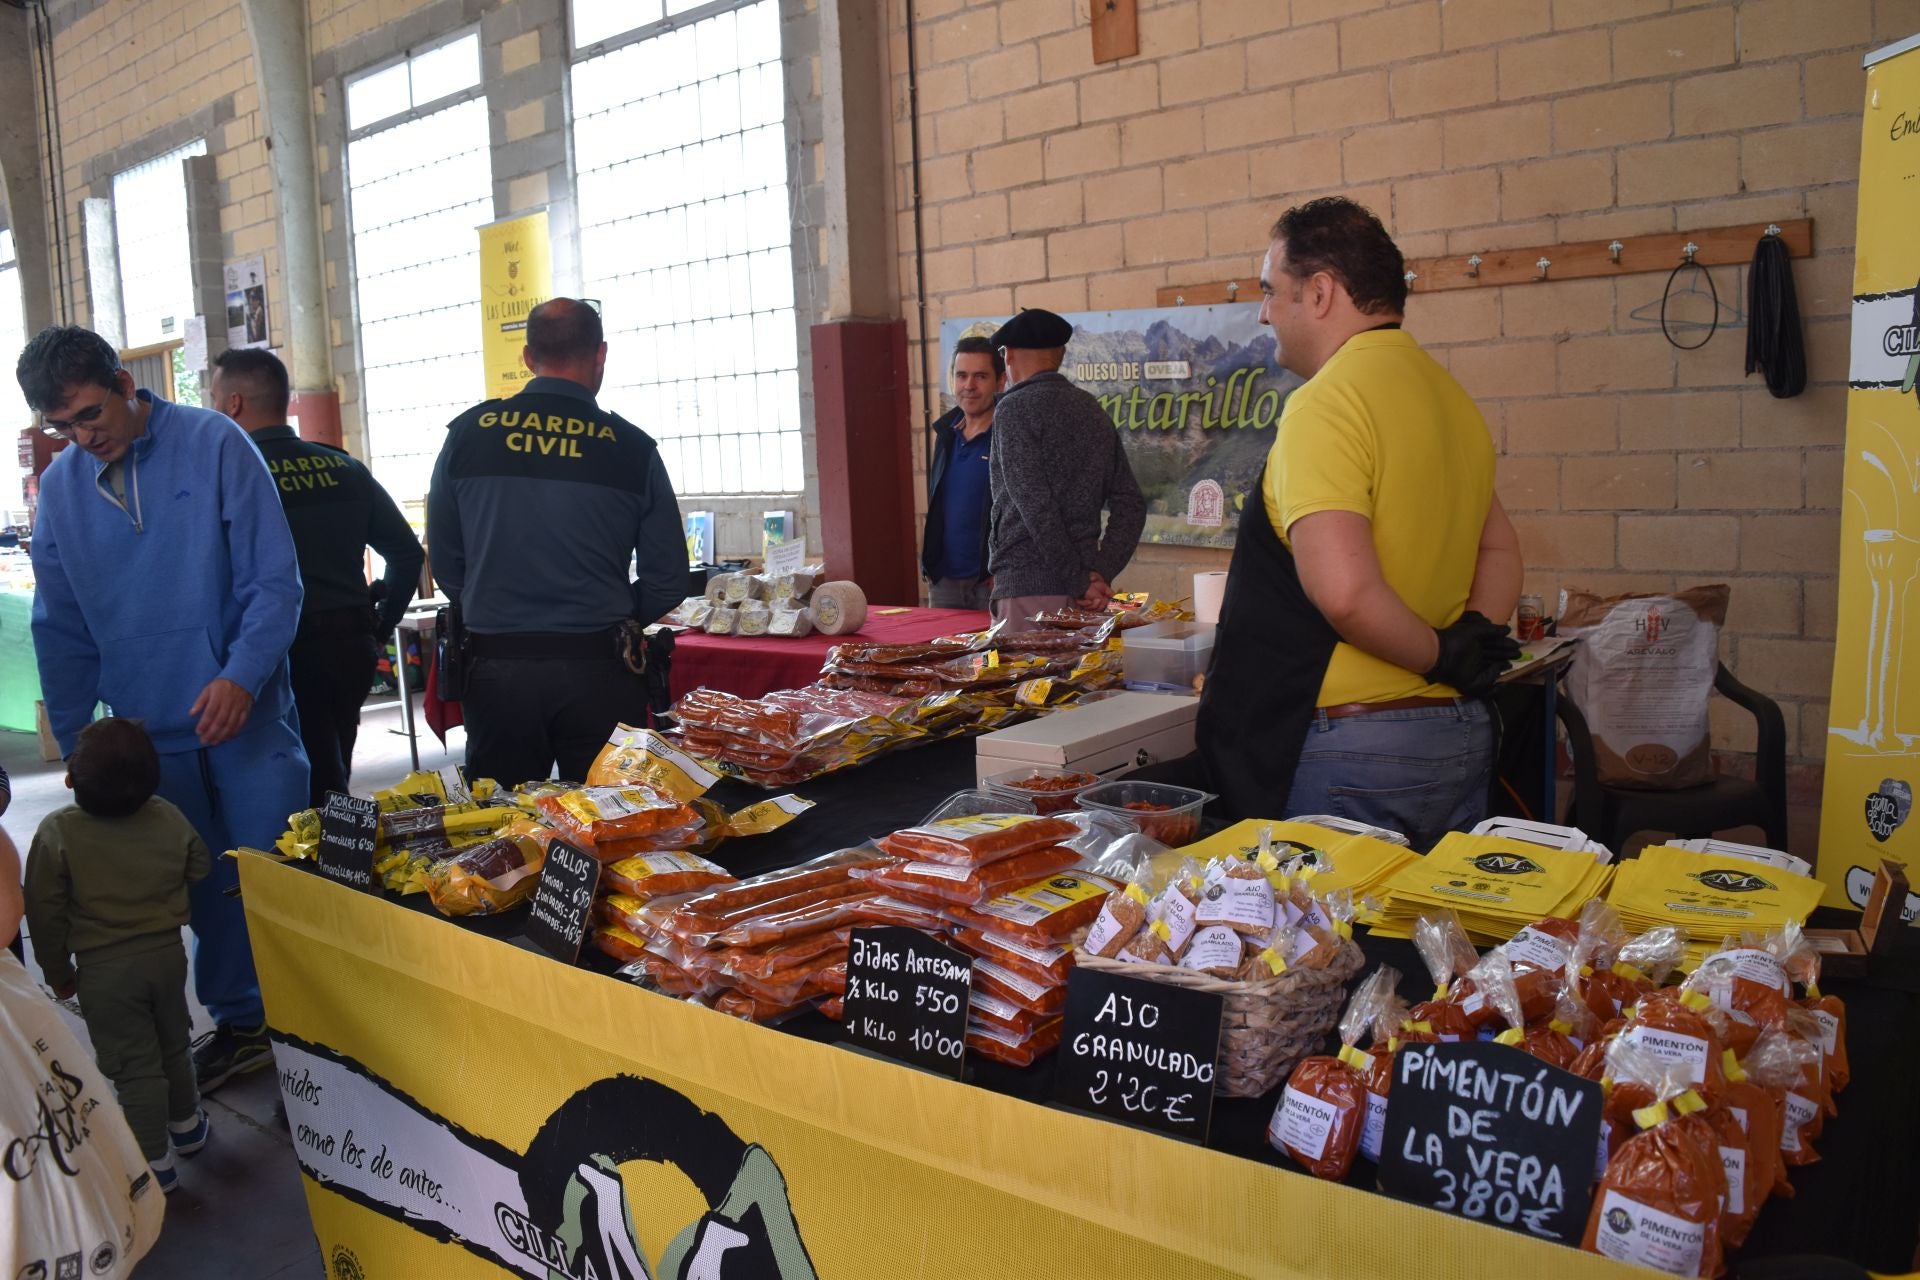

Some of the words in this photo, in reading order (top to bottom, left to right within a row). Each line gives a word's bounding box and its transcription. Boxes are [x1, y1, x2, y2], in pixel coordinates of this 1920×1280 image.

[502, 371, 518, 381] MIEL
[1077, 362, 1118, 381] QUESO
[1122, 362, 1140, 380] DE
[1096, 367, 1296, 431] ntarillo
[478, 410, 617, 442] GUARDIA
[505, 432, 583, 458] CIVIL
[270, 455, 349, 475] UARDIA
[279, 472, 339, 493] CIVIL
[1635, 619, 1646, 632] H
[1661, 618, 1671, 632] V
[321, 829, 326, 840] 2
[541, 867, 547, 881] 1
[551, 845, 590, 881] CALLOS
[531, 902, 537, 916] 3
[536, 887, 541, 901] 2
[568, 908, 580, 926] 12
[1209, 932, 1226, 940] AJO
[905, 948, 971, 985] ARTESANA
[915, 985, 959, 1014] 5'50
[1094, 992, 1159, 1028] AJO
[846, 1020, 855, 1035] 1
[908, 1027, 964, 1059] 10'00
[1641, 1035, 1704, 1053] PIMENTÓN
[1073, 1033, 1214, 1083] GRANULADO
[278, 1068, 323, 1106] utidos
[1286, 1096, 1331, 1121] PIMENTÓN
[1448, 1104, 1500, 1143] DE
[297, 1123, 336, 1156] como
[341, 1129, 368, 1170] los
[370, 1144, 394, 1179] de
[1402, 1126, 1443, 1168] LA
[1466, 1144, 1565, 1212] VERA
[1640, 1217, 1702, 1243] PIMENTÓN
[1640, 1231, 1650, 1239] DE
[1651, 1235, 1660, 1243] LA
[1662, 1240, 1682, 1251] VERA
